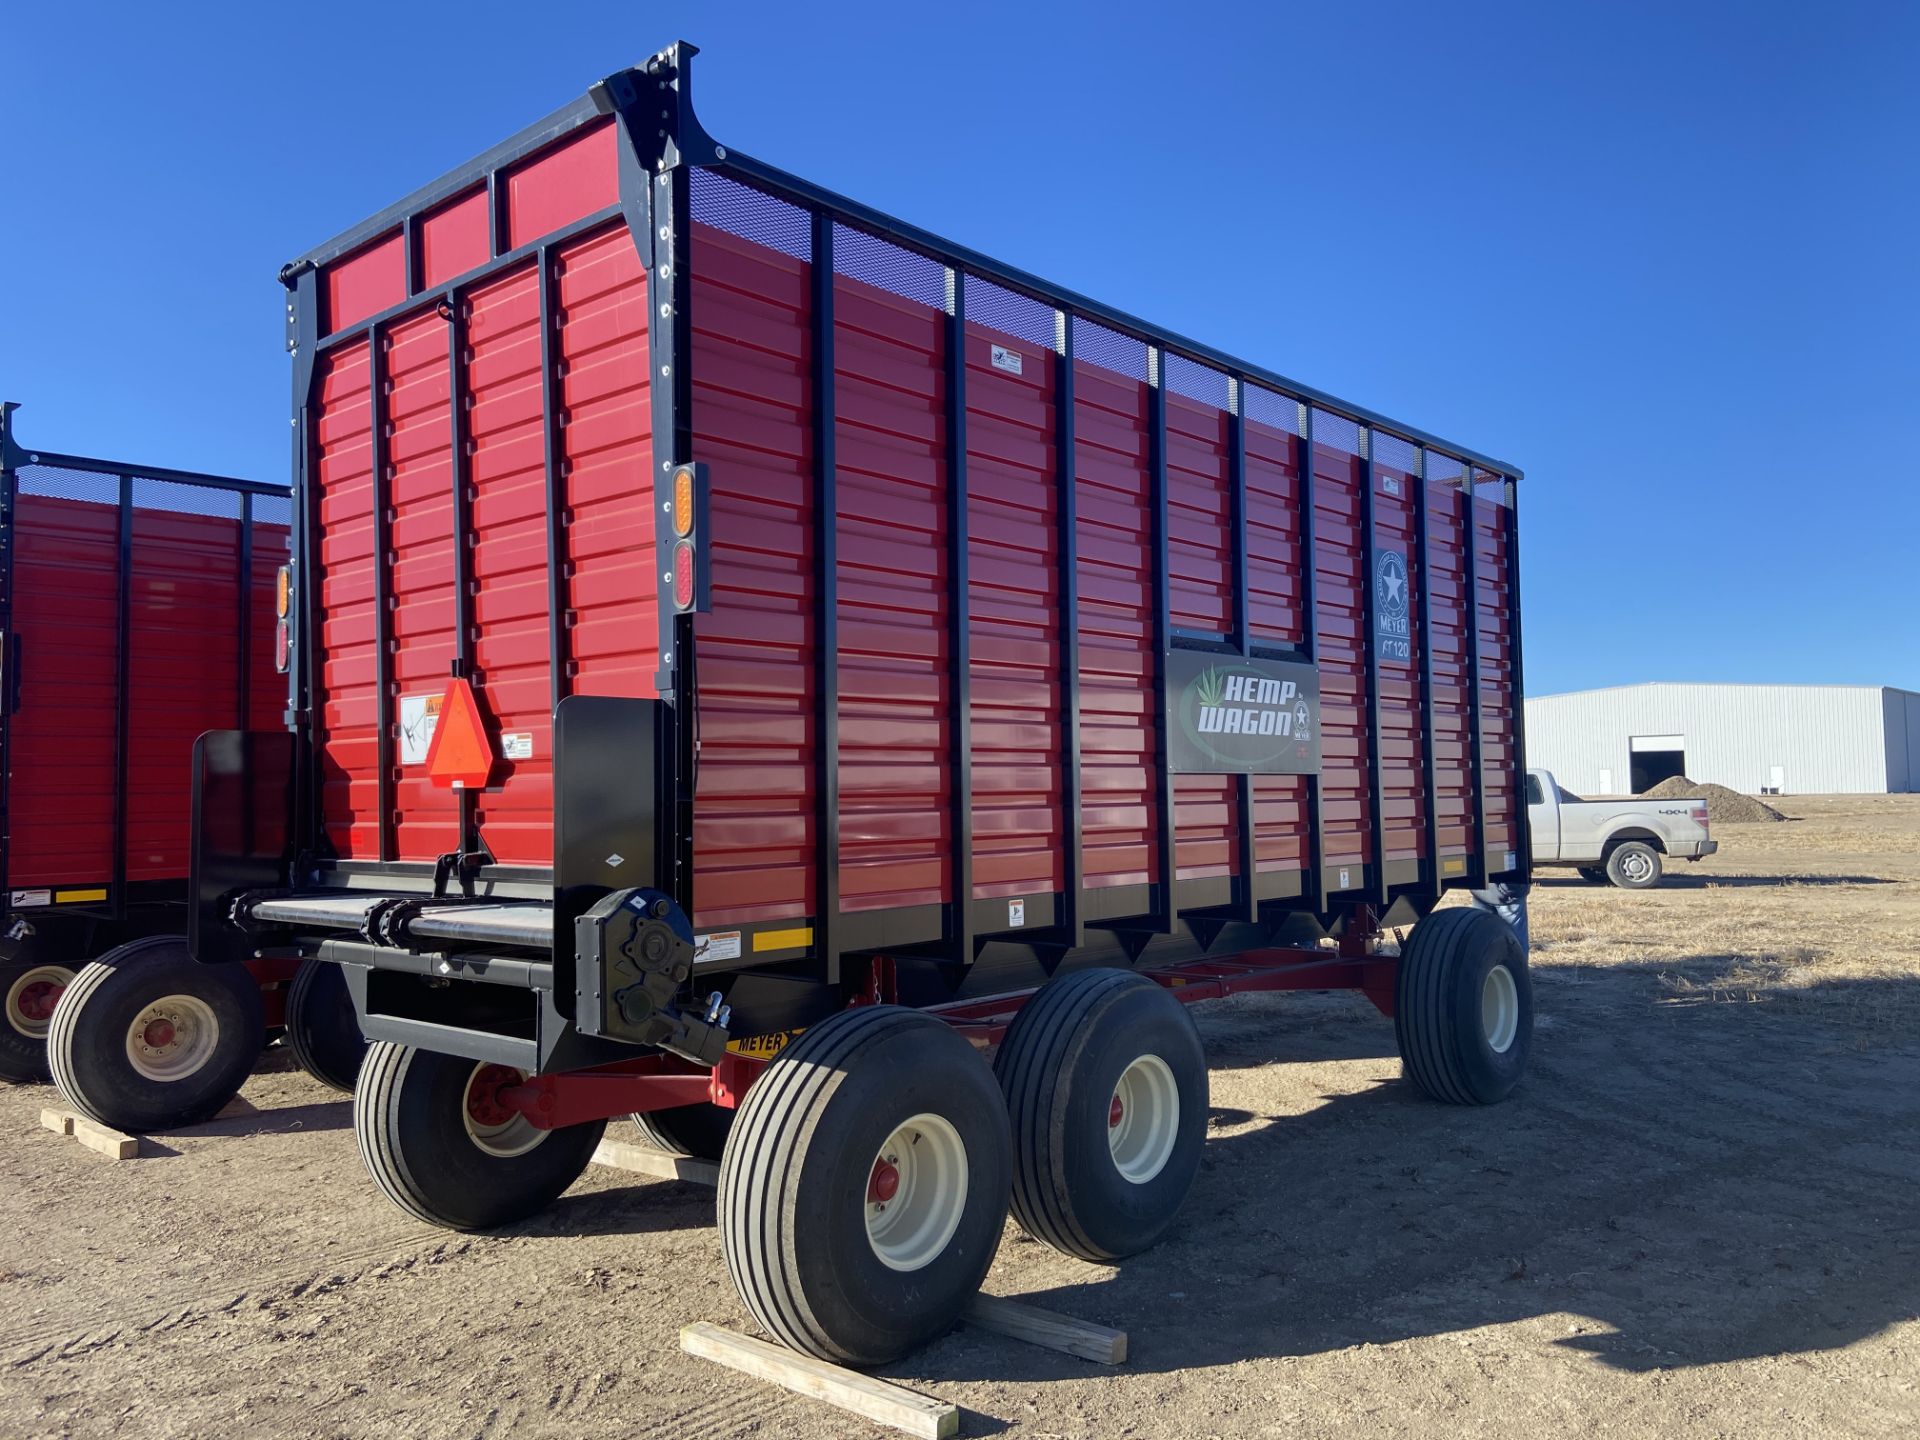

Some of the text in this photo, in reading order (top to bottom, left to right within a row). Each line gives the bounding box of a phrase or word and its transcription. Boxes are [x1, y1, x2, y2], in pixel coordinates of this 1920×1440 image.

[1380, 614, 1407, 634] MEYER
[1225, 675, 1297, 705] HEMP
[1198, 706, 1291, 736] WAGON
[738, 1033, 783, 1052] MEYER
